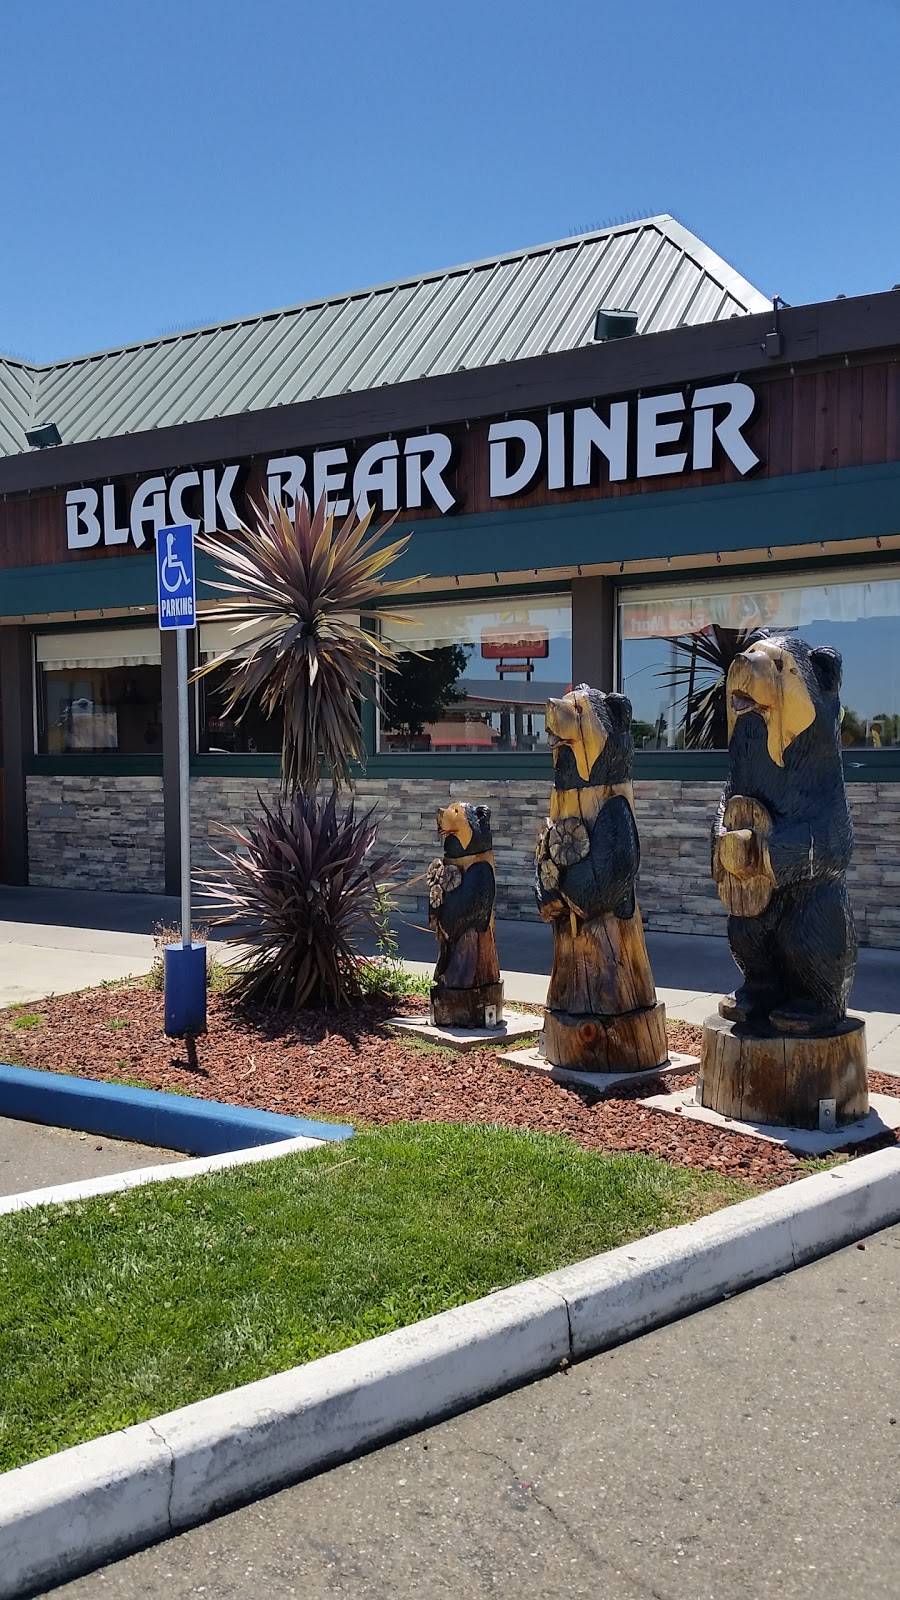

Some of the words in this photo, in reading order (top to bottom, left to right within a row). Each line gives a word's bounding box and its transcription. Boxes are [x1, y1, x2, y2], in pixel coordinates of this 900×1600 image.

[65, 465, 242, 549] BLACK
[266, 432, 456, 525] BEAR
[487, 382, 760, 498] DINER
[161, 596, 193, 618] PARKING
